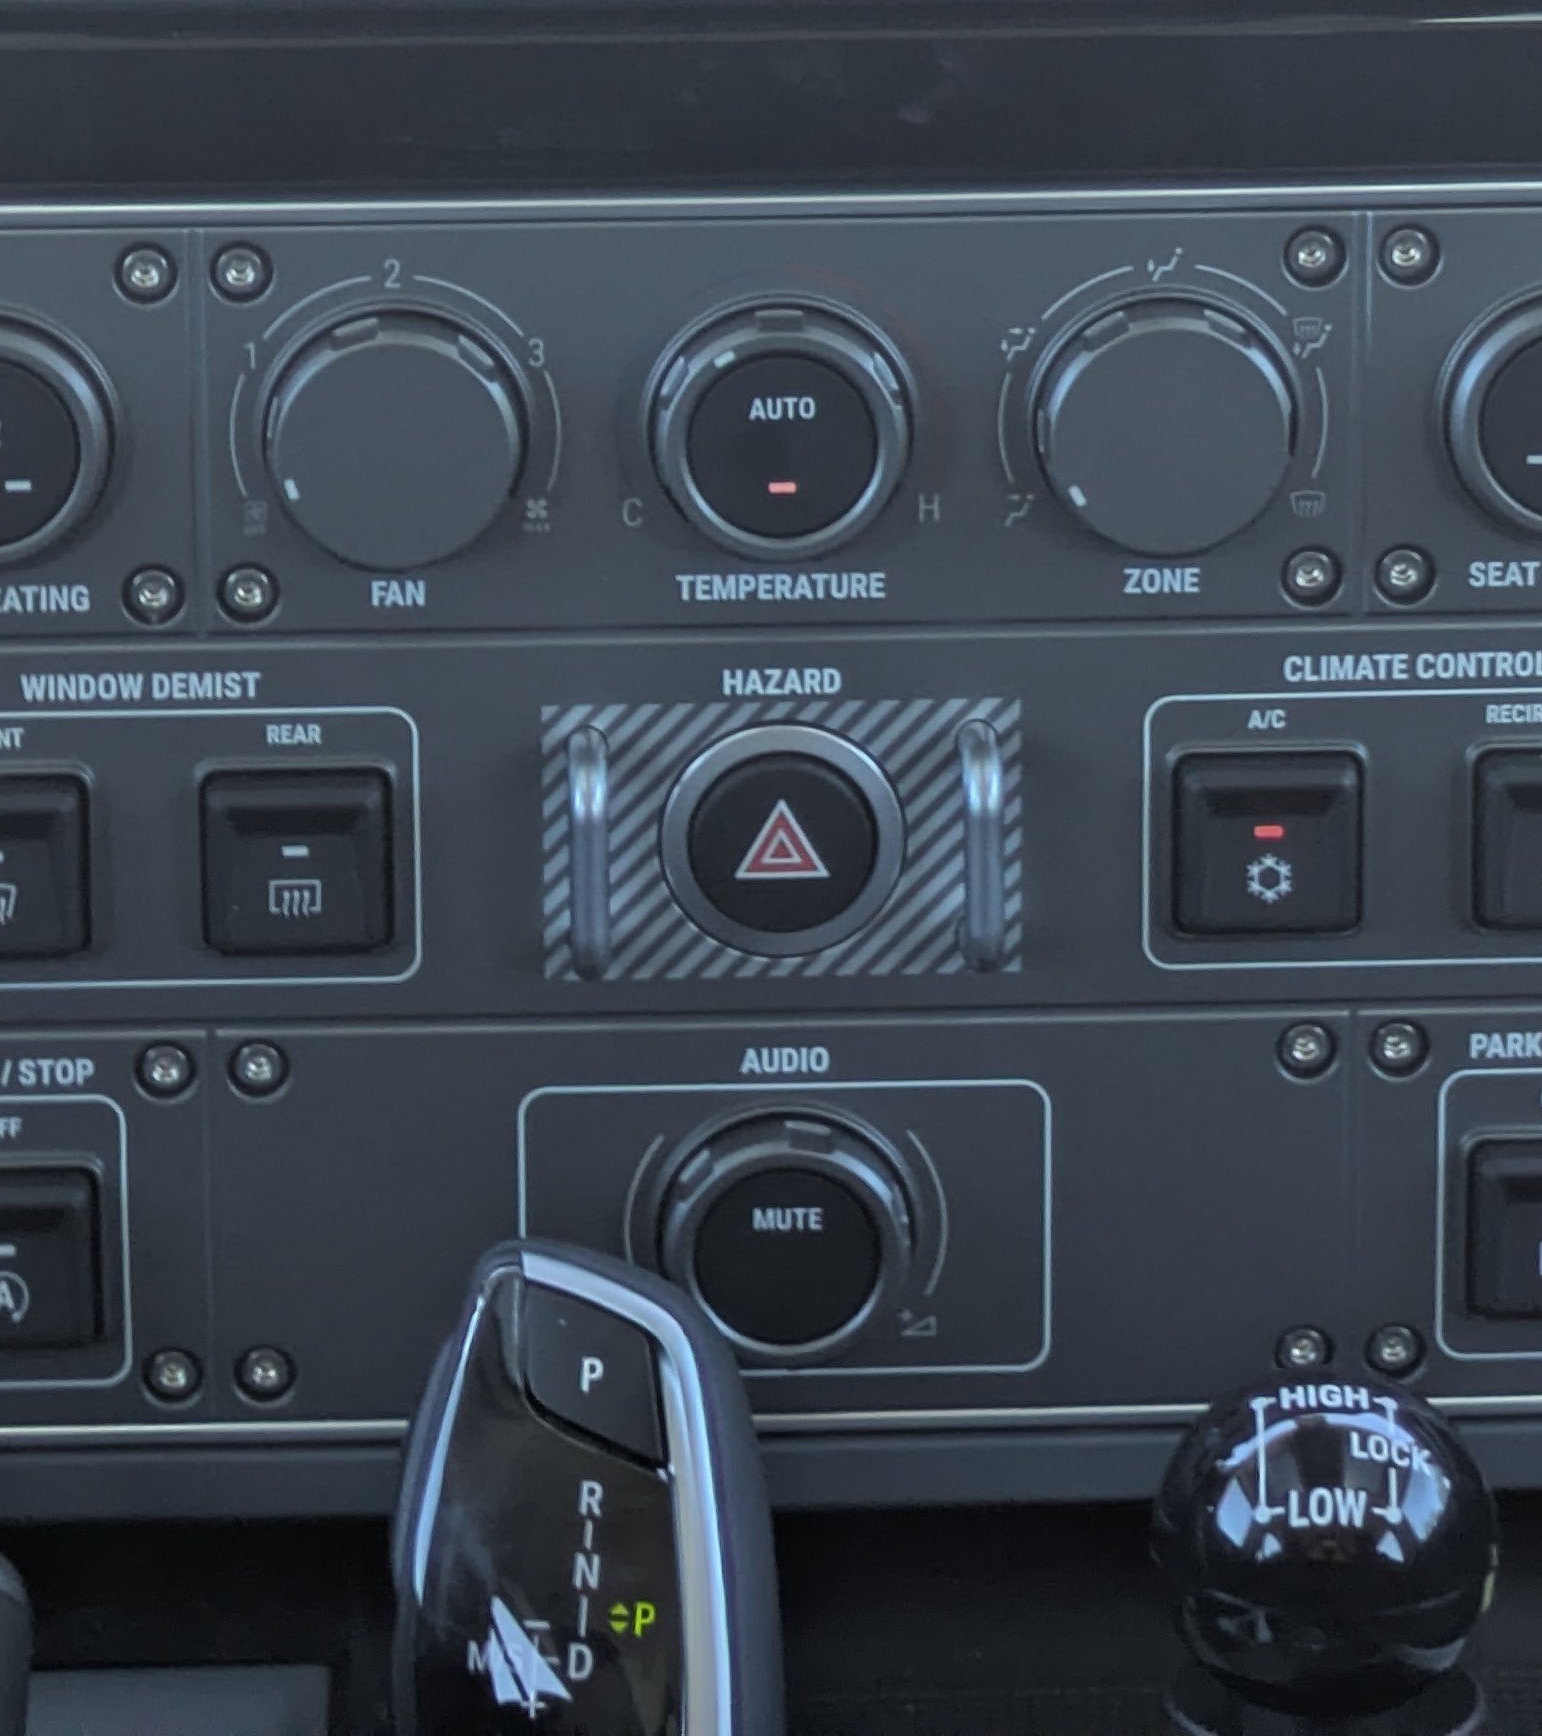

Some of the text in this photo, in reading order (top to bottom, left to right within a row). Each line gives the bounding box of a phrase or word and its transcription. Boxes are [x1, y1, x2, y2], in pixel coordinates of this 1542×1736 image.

[383, 258, 402, 289] 2
[244, 341, 256, 370] 1
[528, 337, 545, 368] 3
[749, 396, 816, 420] AUTO
[621, 497, 643, 528] C
[918, 493, 941, 523] H
[675, 571, 886, 601] TEMPERATURE
[1123, 567, 1201, 594] ZONE
[1468, 561, 1538, 588] SEAT
[371, 580, 426, 607] FAN
[722, 667, 842, 696] HAZARD
[1283, 653, 1409, 683] CLIMATE
[20, 671, 261, 702] WINDOW DEMIST
[266, 723, 322, 745] REAR
[1247, 708, 1286, 730] A/C
[740, 1046, 830, 1074] AUDIO
[752, 1207, 823, 1231] MUTE
[580, 1357, 604, 1393] P
[1279, 1384, 1370, 1415] HIGH
[1349, 1430, 1432, 1472] LOCK
[579, 1480, 603, 1517] R
[1288, 1486, 1368, 1528] LOW
[573, 1552, 601, 1590] N
[634, 1602, 656, 1637] P
[567, 1642, 594, 1681] D
